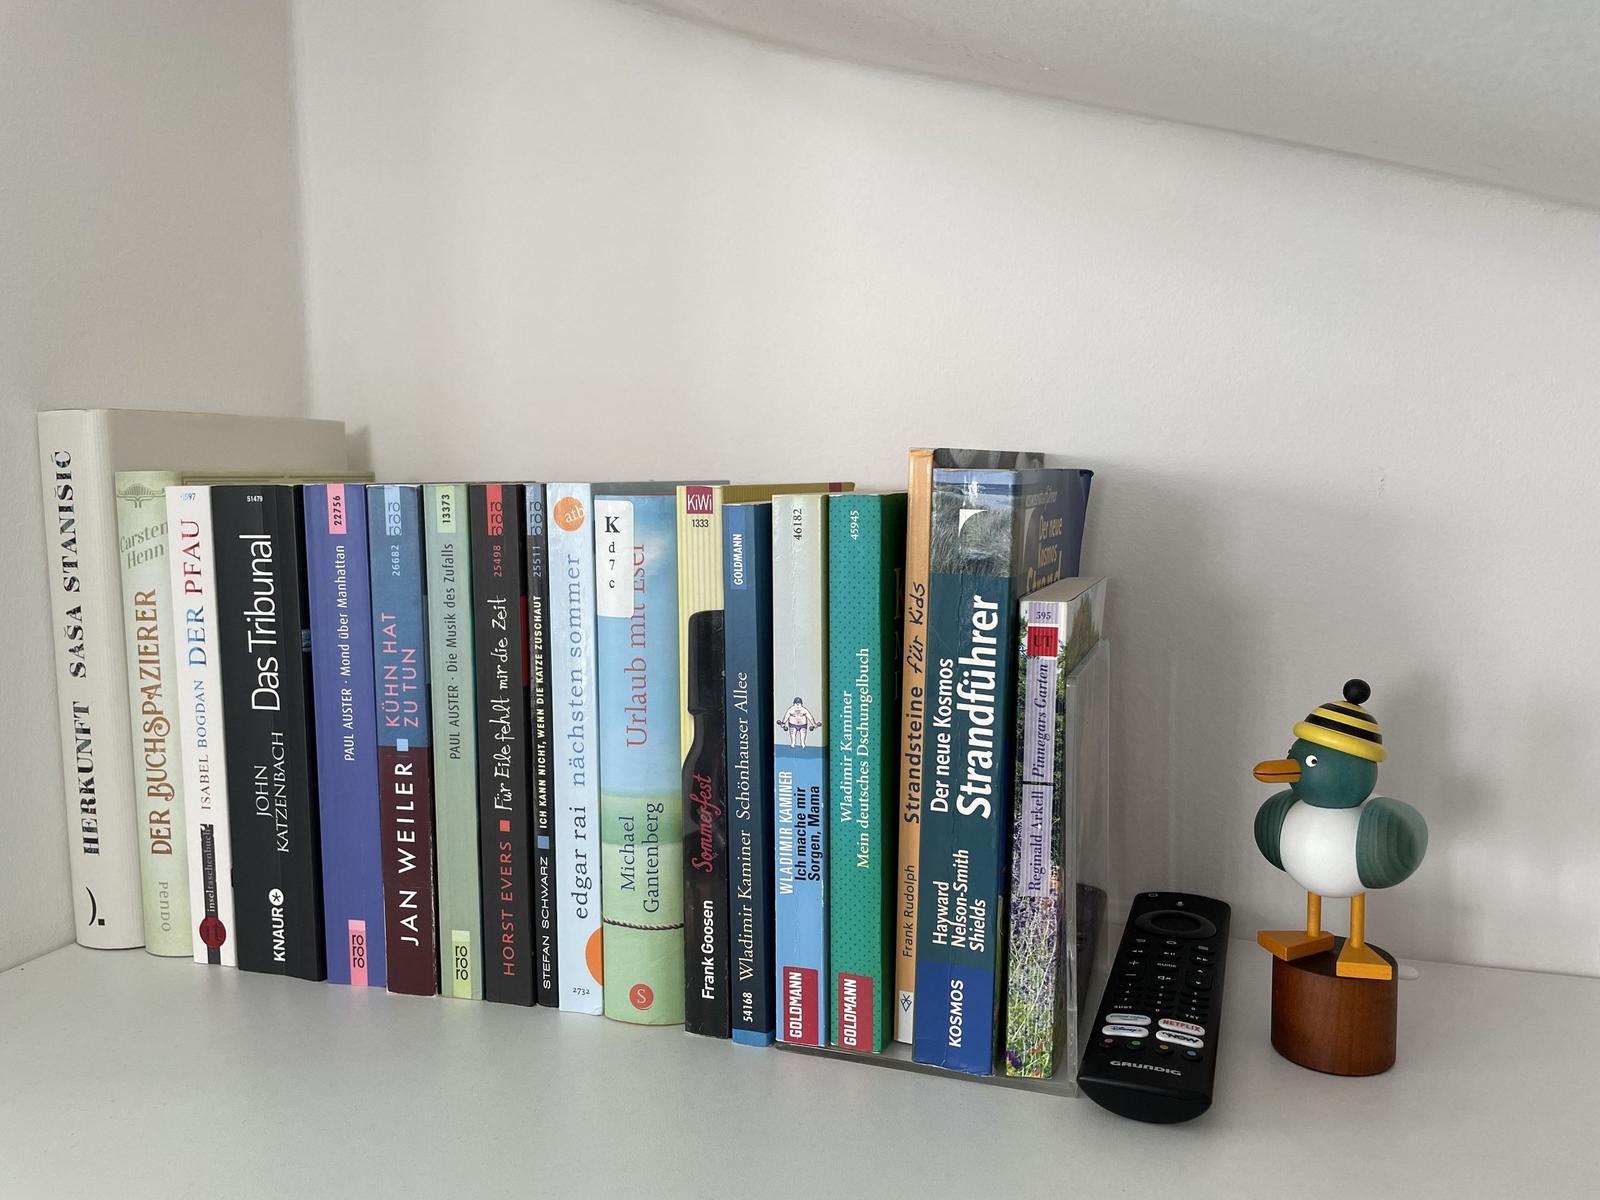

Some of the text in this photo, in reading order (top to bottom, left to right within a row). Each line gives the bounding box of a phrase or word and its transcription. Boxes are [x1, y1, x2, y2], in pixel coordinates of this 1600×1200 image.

[120, 521, 168, 553] Carsten
[333, 495, 342, 526] 22756
[441, 494, 451, 523] 13373
[564, 505, 585, 523] atb
[605, 516, 620, 533] K
[687, 488, 713, 511] KiWi
[691, 518, 709, 528] 1333
[793, 508, 803, 541] 46182
[850, 510, 859, 541] 45945
[51, 450, 87, 679] SAŠA STANIŠIĆ
[127, 544, 164, 569] Henn
[180, 520, 207, 667] DER PFAU
[391, 545, 401, 576] 26682
[493, 545, 502, 577] 25498
[533, 545, 542, 577] 25511
[608, 541, 615, 553] d
[608, 580, 615, 589] c
[609, 559, 615, 571] 7
[734, 533, 743, 585] GOLDMANN
[239, 534, 281, 711] Das Tribunal
[334, 545, 355, 761] PAUL AUSTER Mond über Manhattan
[441, 543, 461, 759] PAUL AUSTER Die Musik des Zufalls
[1036, 611, 1052, 620] 595
[380, 612, 400, 727] KÜHN HAT
[401, 648, 419, 728] ZU TUN
[487, 595, 515, 810] Für Eile fehlt mir die Zeit
[533, 595, 548, 829] ICH KANN NICHT, WENN DIE KATZE ZUSCHAUT
[567, 554, 585, 787] nächsten sommer
[624, 657, 648, 748] Urlaub
[904, 581, 925, 824] Strandsteine für Kids
[956, 594, 999, 820] Strandführer
[134, 588, 175, 856] DER BUCHSPAZIERER
[193, 679, 211, 810] ISABEL BOGDAN
[733, 671, 750, 820] Schönhauser Allee
[839, 691, 853, 824] Wladimir Kaminer
[855, 648, 873, 869] Mein deutsches Dschungelbuch
[930, 658, 954, 813] Der neue Kosmos
[1032, 664, 1050, 778] Pinnegars Garten
[73, 701, 100, 856] HERKUNFT
[254, 765, 273, 817] JOHN
[271, 731, 289, 853] KATZENBACH
[688, 775, 722, 873] Sommerfest
[394, 762, 419, 946] JAN WEILER
[569, 806, 592, 919] edgar rai
[618, 815, 636, 891] Michael
[641, 802, 664, 913] Gantenberg
[779, 770, 793, 895] WLADIMIR KAMINER
[794, 787, 806, 881] Ich mache mir
[808, 785, 823, 881] Sorgen, Mama
[1028, 791, 1046, 891] Reginald Arkell
[271, 907, 286, 962] KNAUR
[500, 841, 515, 976] HORST EVERS
[540, 856, 551, 989] STEFAN SCHWARZ
[737, 830, 753, 981] Wladimir Kaminer
[903, 865, 918, 958] Frank Rudolph
[932, 881, 958, 945] Hayward
[951, 849, 969, 948] Nelson-Smith
[970, 899, 986, 952] Shields
[572, 986, 590, 996] 2732
[701, 900, 715, 999] Frank Goosen
[636, 989, 647, 1004] S
[742, 992, 753, 1023] 54168
[788, 972, 803, 1039] GOLDMANN
[843, 978, 857, 1046] GOLDMANN
[948, 979, 964, 1048] KOSMOS
[1162, 1019, 1201, 1033] NETFLIX
[1109, 1060, 1182, 1076] GRUNDIG
